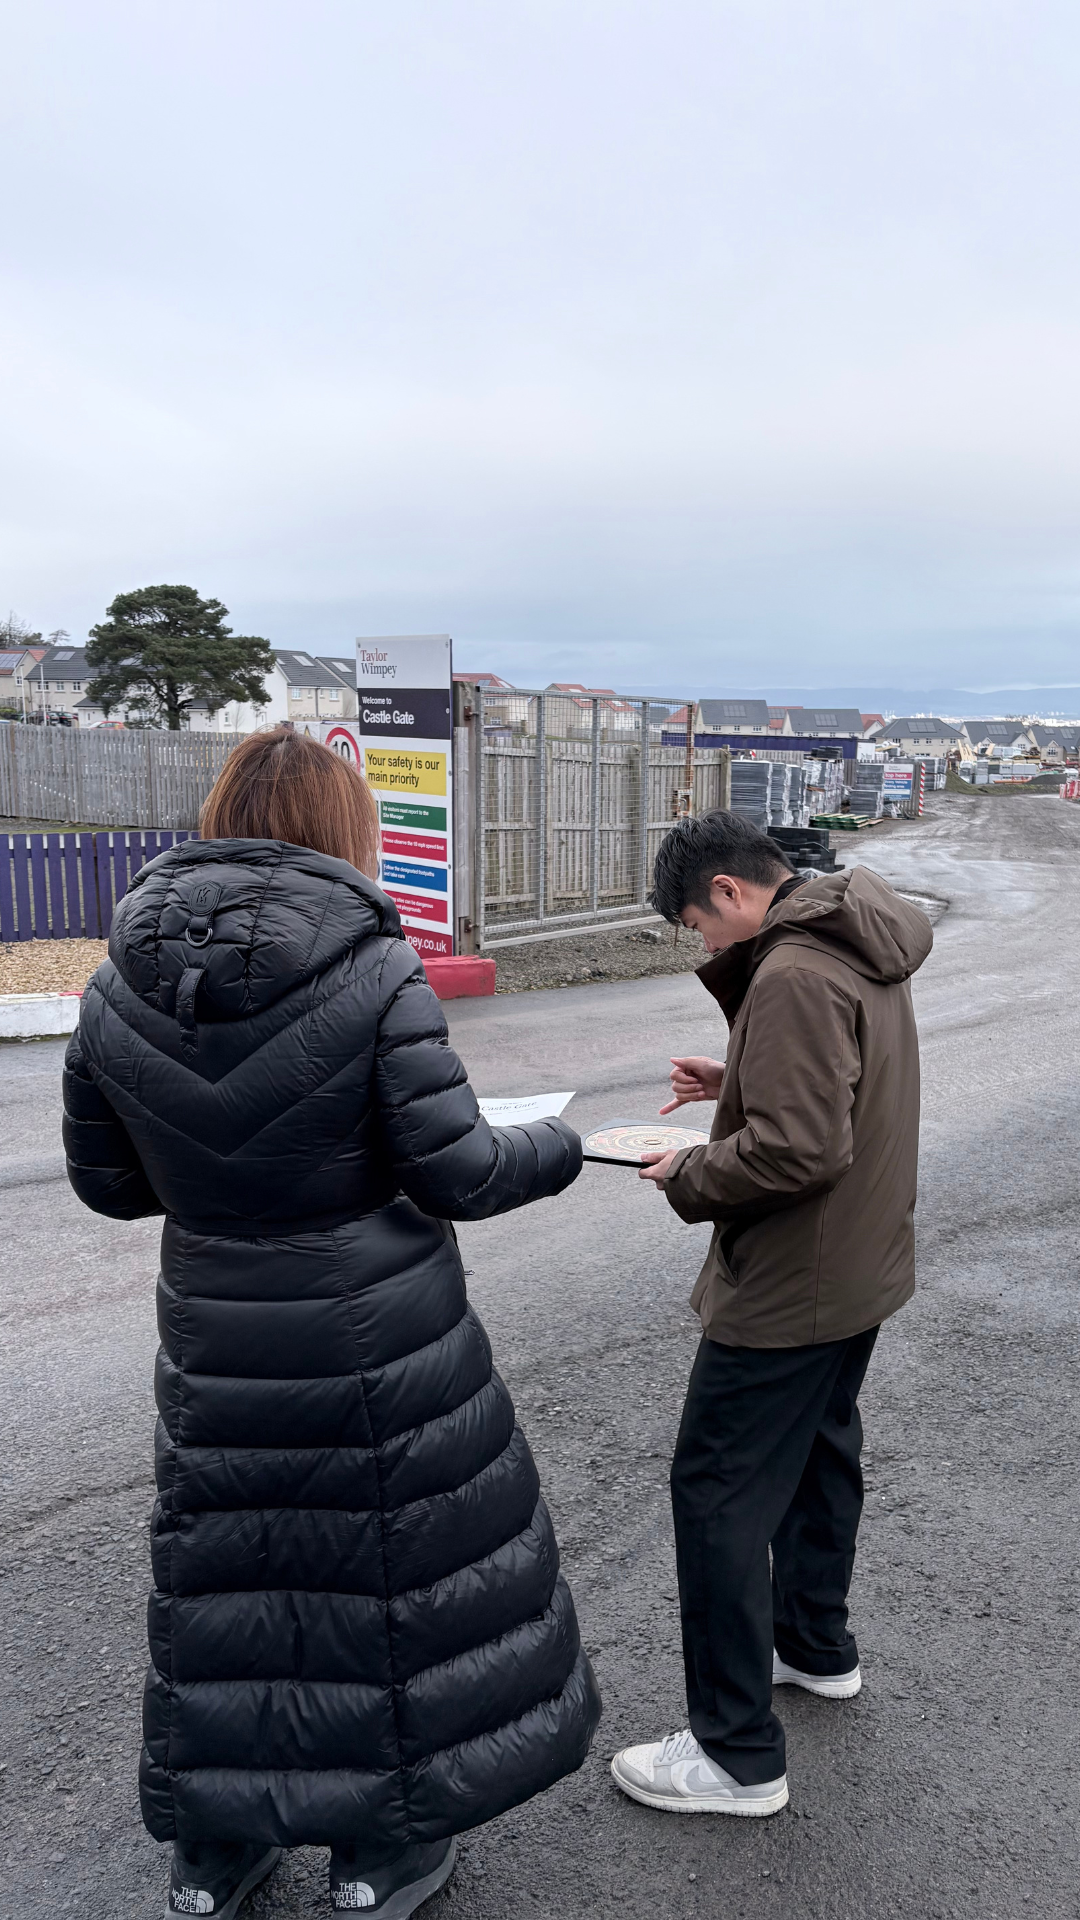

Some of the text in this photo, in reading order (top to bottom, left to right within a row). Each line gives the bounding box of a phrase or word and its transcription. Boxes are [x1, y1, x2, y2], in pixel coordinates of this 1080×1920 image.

[360, 648, 388, 663] Taylor
[361, 662, 397, 678] Wimpey
[361, 696, 392, 705] Welcome to
[362, 709, 415, 725] Castle Gate
[332, 741, 351, 761] 10
[367, 754, 440, 771] Your safety is our
[368, 771, 419, 788] main priority
[181, 1886, 198, 1899] THE
[339, 1882, 357, 1892] THE
[172, 1887, 197, 1906] NORTH
[330, 1890, 357, 1900] NORTH
[174, 1900, 196, 1913] FACE
[335, 1899, 357, 1908] FACE
